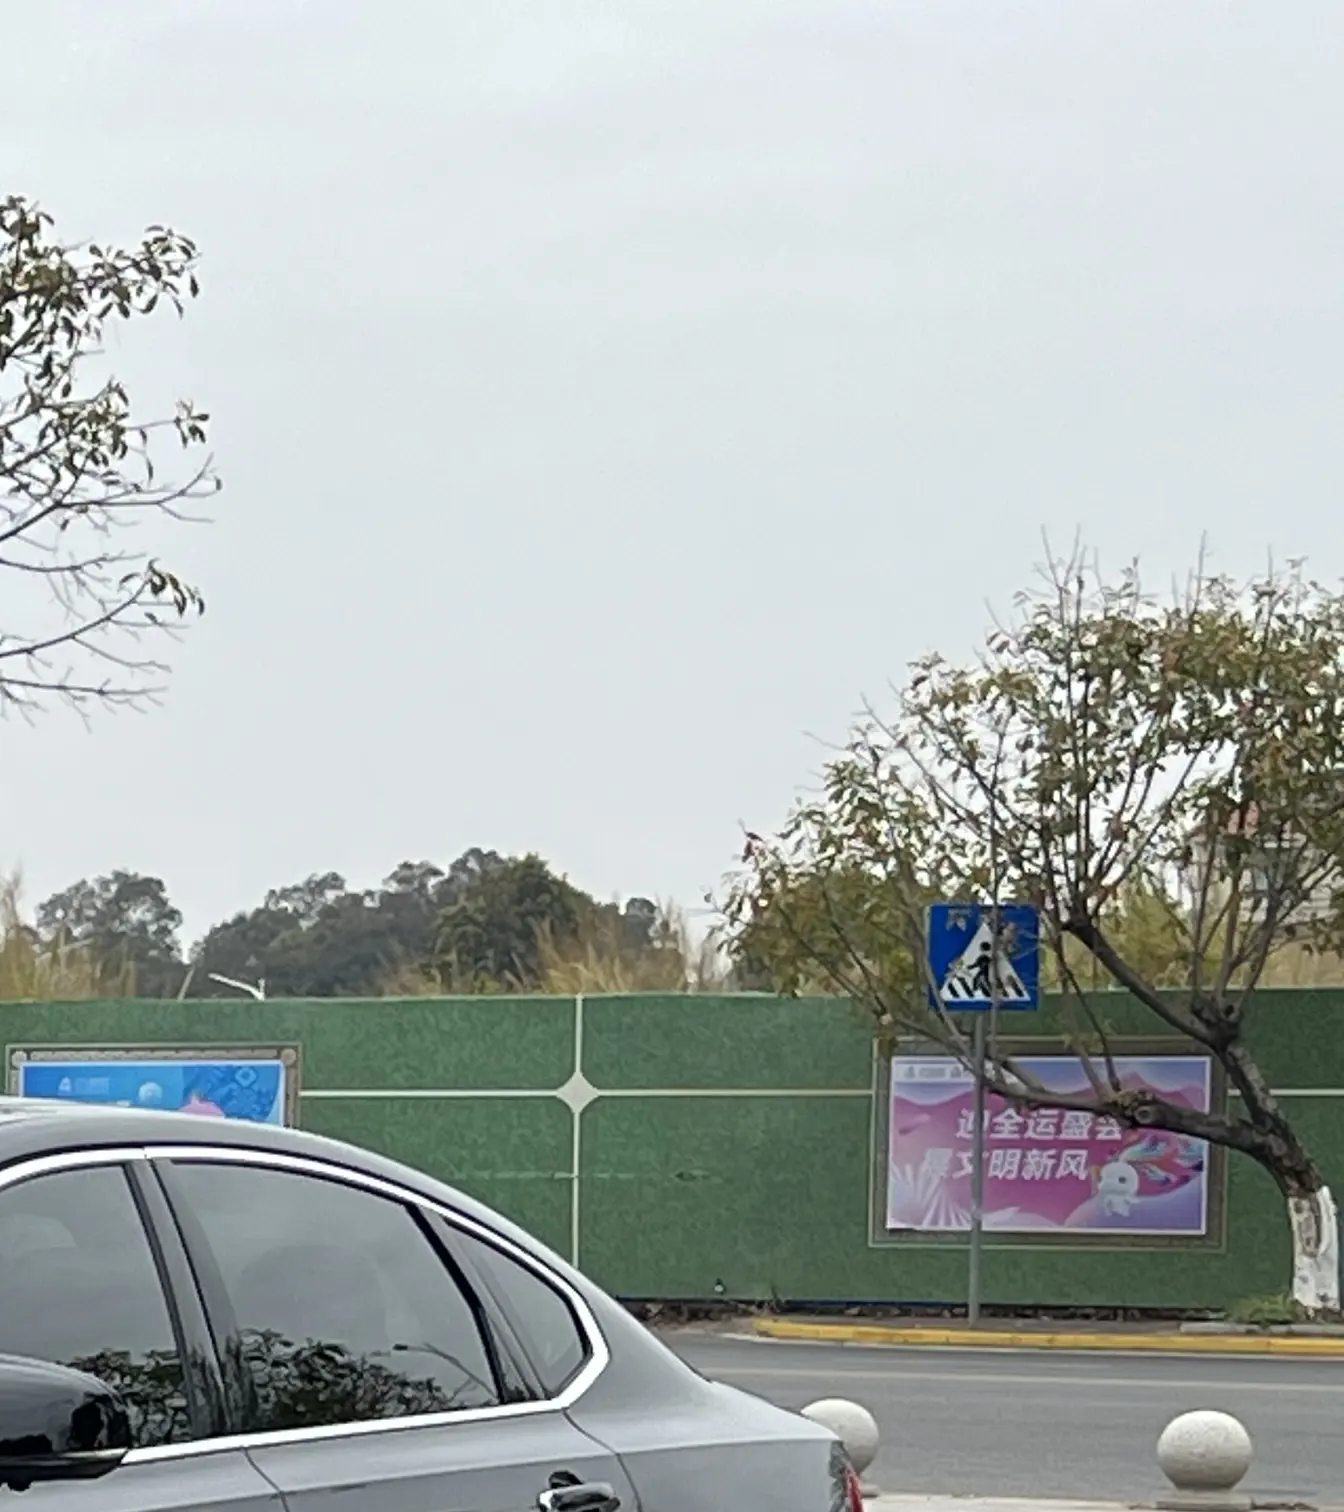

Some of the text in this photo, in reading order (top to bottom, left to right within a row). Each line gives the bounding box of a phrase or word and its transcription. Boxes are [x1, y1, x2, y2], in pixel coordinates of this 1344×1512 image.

[954, 1107, 1122, 1140] 迎全运盛会
